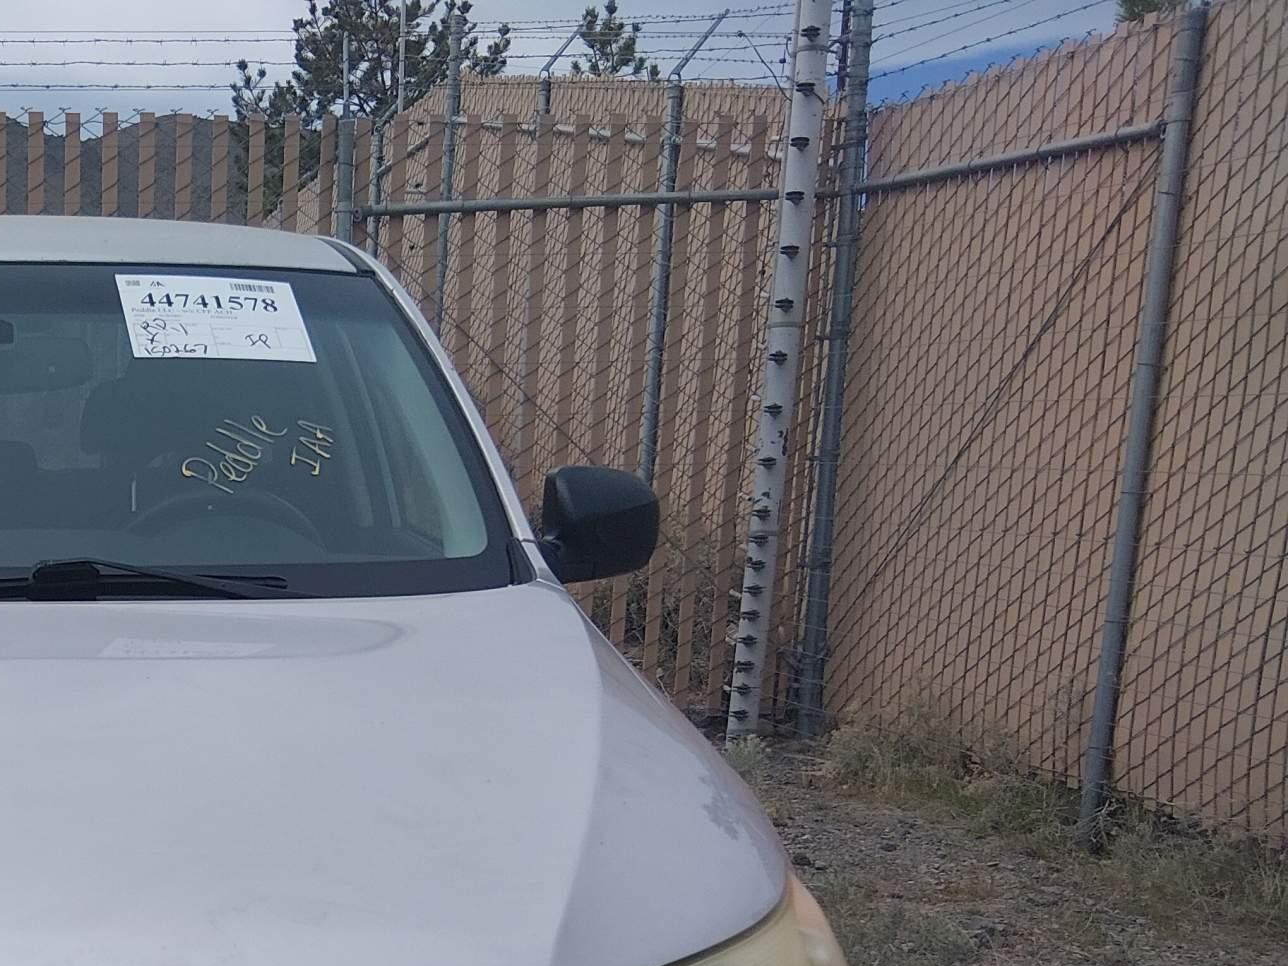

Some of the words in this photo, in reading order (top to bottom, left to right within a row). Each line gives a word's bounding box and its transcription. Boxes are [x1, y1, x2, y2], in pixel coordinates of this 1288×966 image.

[140, 292, 278, 313] 44741578
[181, 415, 288, 494] Peddle
[289, 419, 334, 476] IAA
